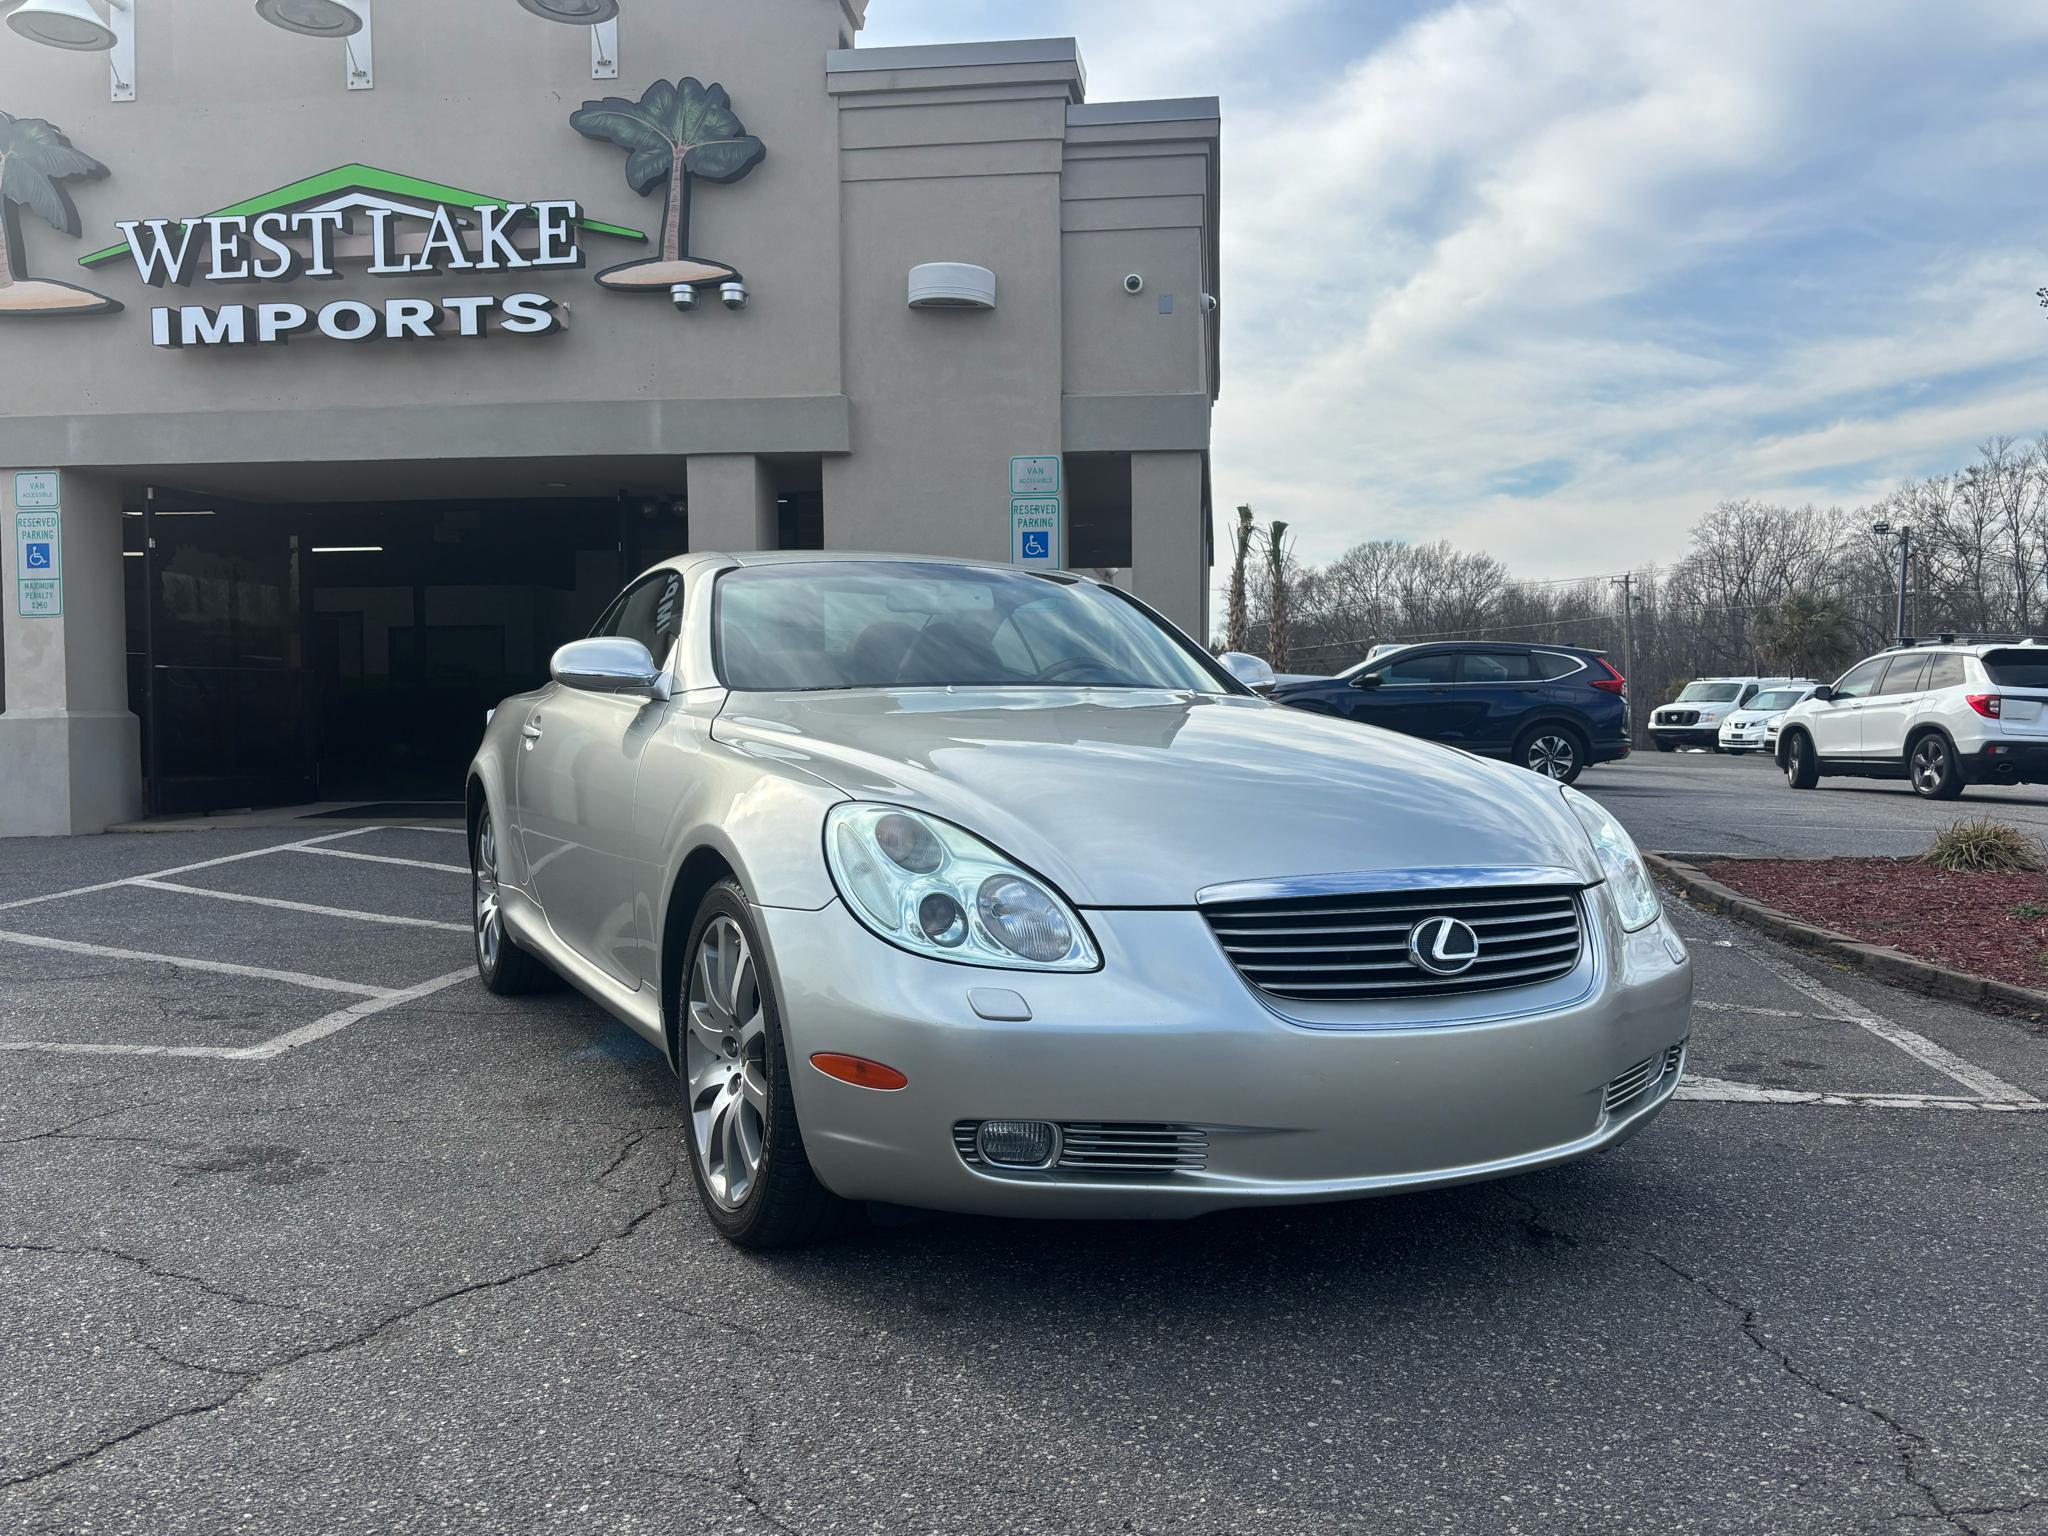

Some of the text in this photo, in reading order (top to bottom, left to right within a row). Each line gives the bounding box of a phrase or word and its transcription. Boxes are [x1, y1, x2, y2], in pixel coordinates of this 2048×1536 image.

[115, 200, 578, 284] WEST LAKE
[152, 292, 553, 346] IMPORTS
[1027, 467, 1044, 475] VAN
[30, 481, 46, 490] VAN
[1013, 504, 1057, 515] RESERVED
[17, 517, 57, 528] RESERVED
[1017, 517, 1054, 529] PARKING
[22, 530, 54, 541] PARKING
[24, 582, 55, 590] MAXIMUM
[25, 591, 54, 600] PENALTY
